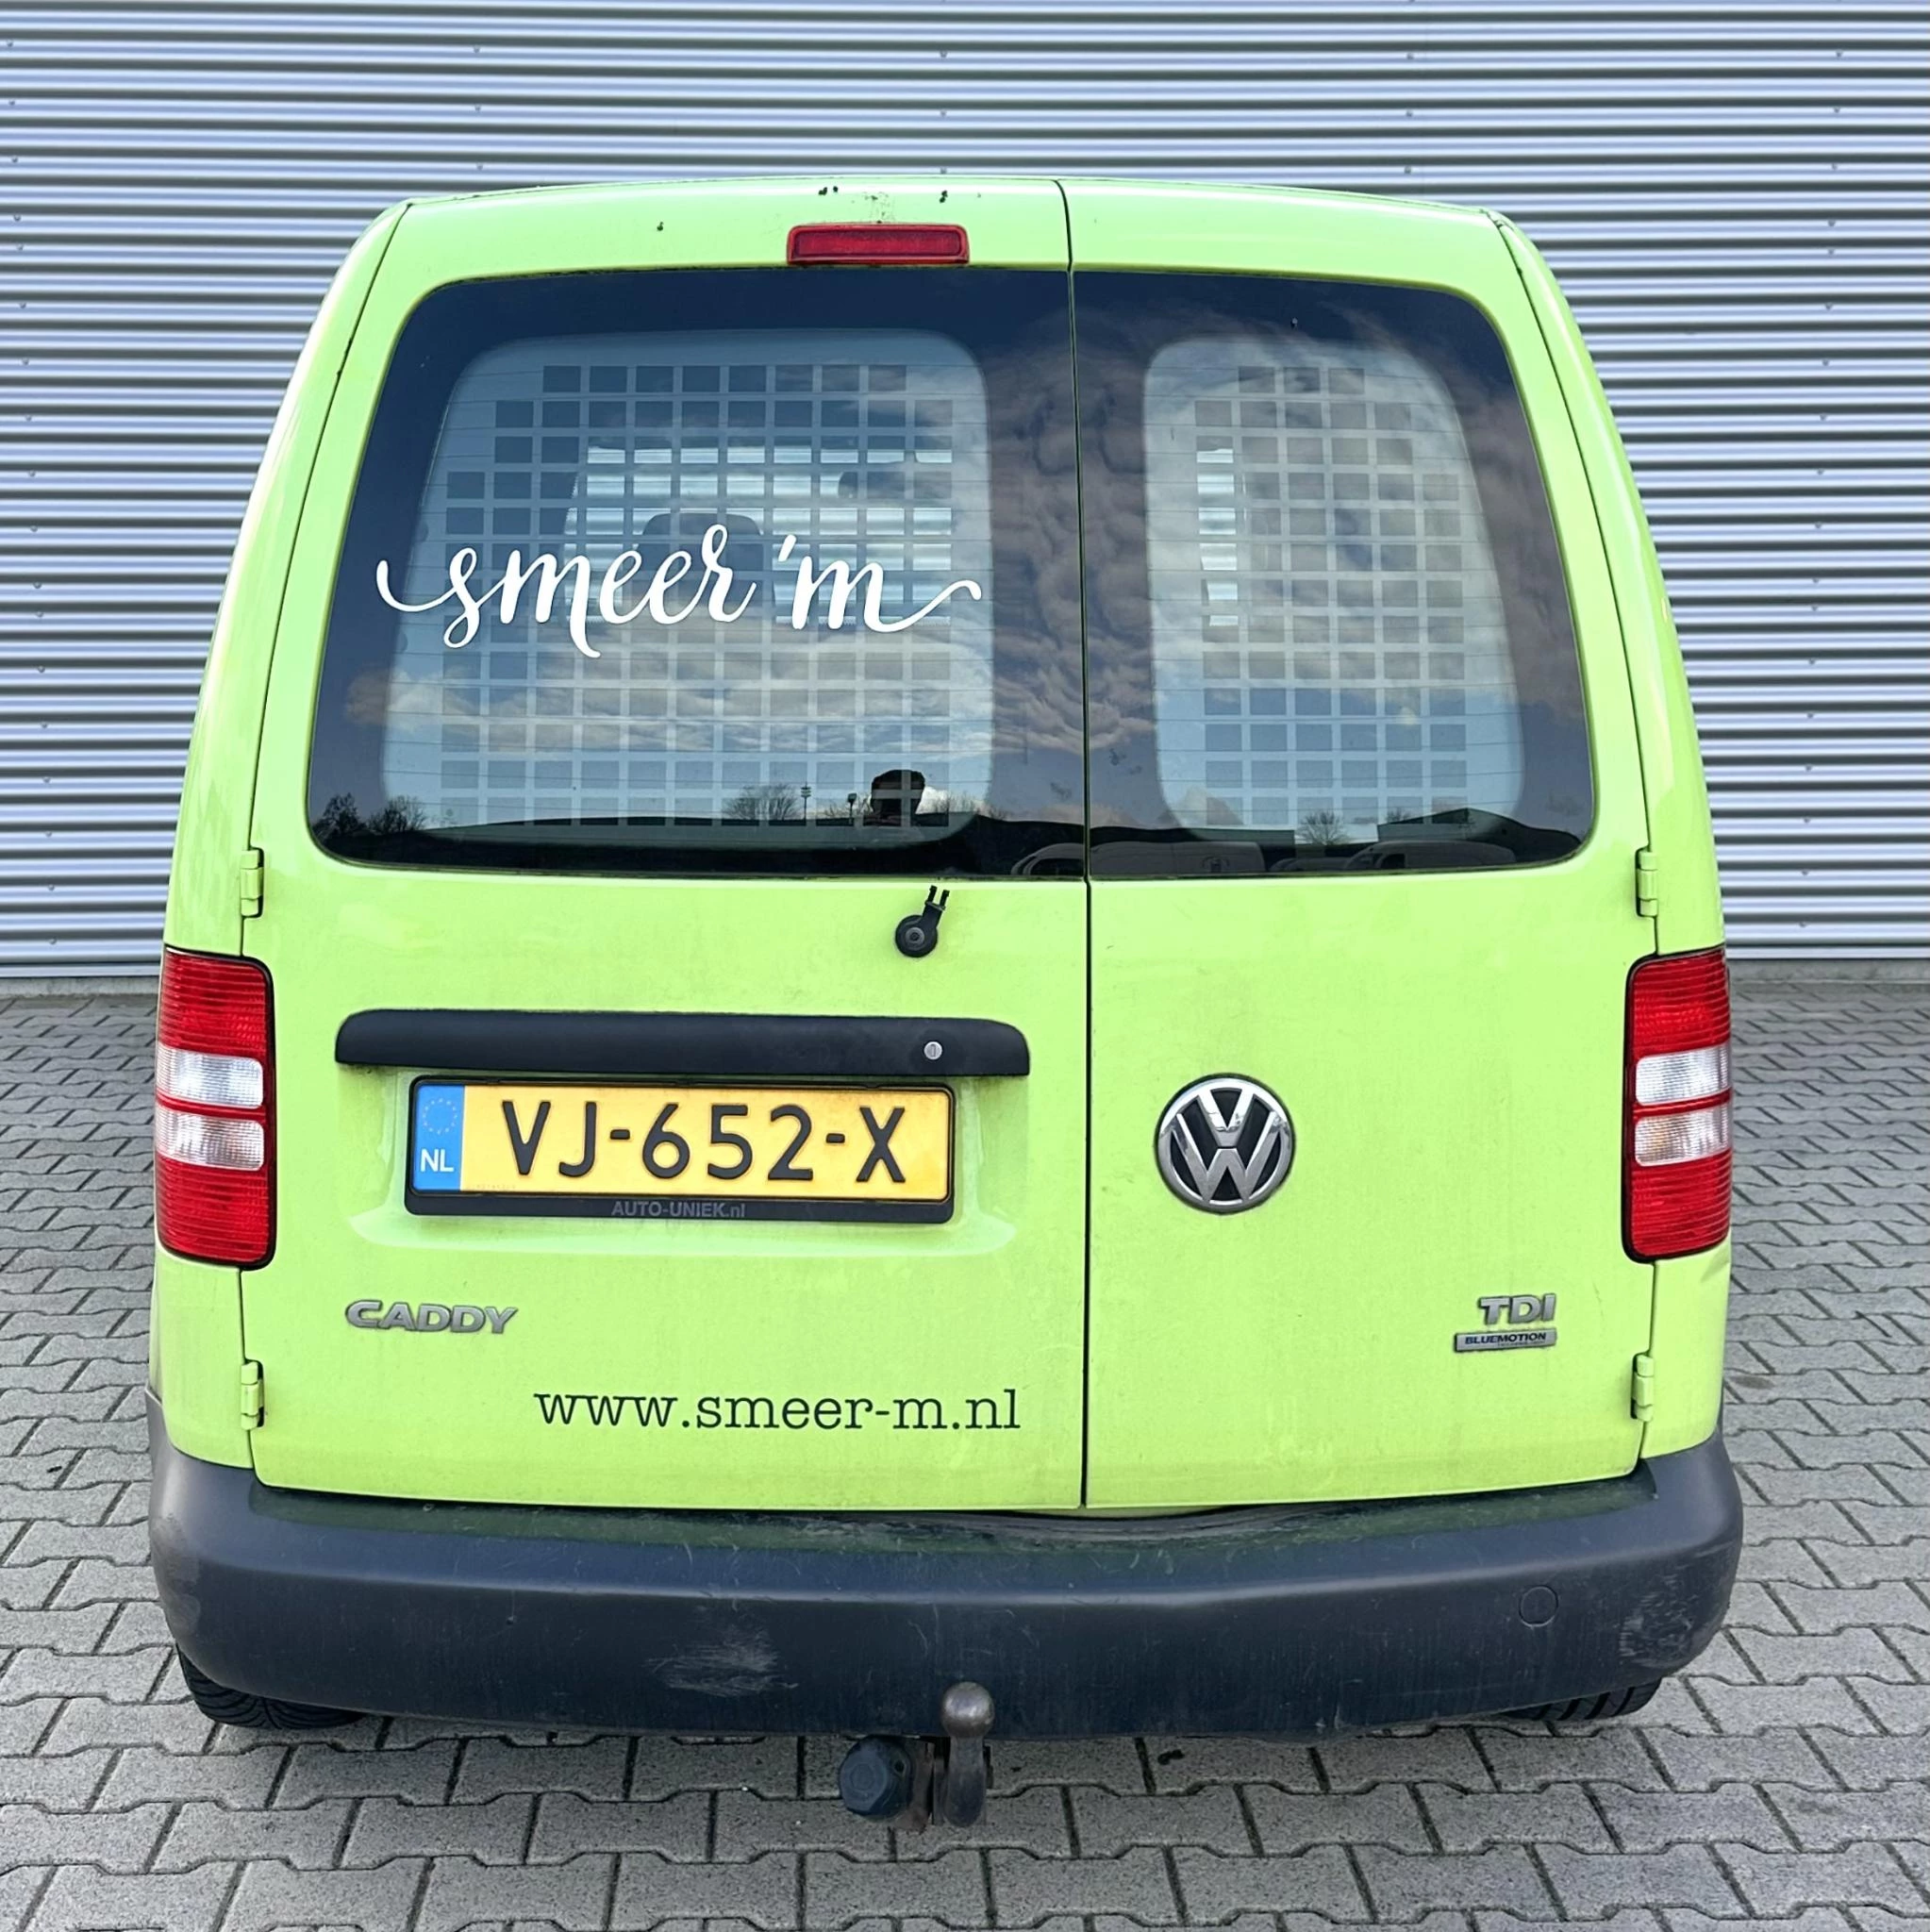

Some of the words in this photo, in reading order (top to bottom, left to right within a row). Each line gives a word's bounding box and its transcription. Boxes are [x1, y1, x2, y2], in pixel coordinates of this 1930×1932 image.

[377, 525, 757, 658] smeer
[502, 1100, 907, 1183] VJ-652-X
[421, 1149, 454, 1173] NL
[611, 1201, 745, 1218] AUTO-UNIEK.nl
[345, 1299, 518, 1334] CADDY
[1477, 1293, 1556, 1325] TDI
[1465, 1332, 1546, 1344] BLUEMOTION
[534, 1389, 1021, 1430] www.smeer-m.nl
